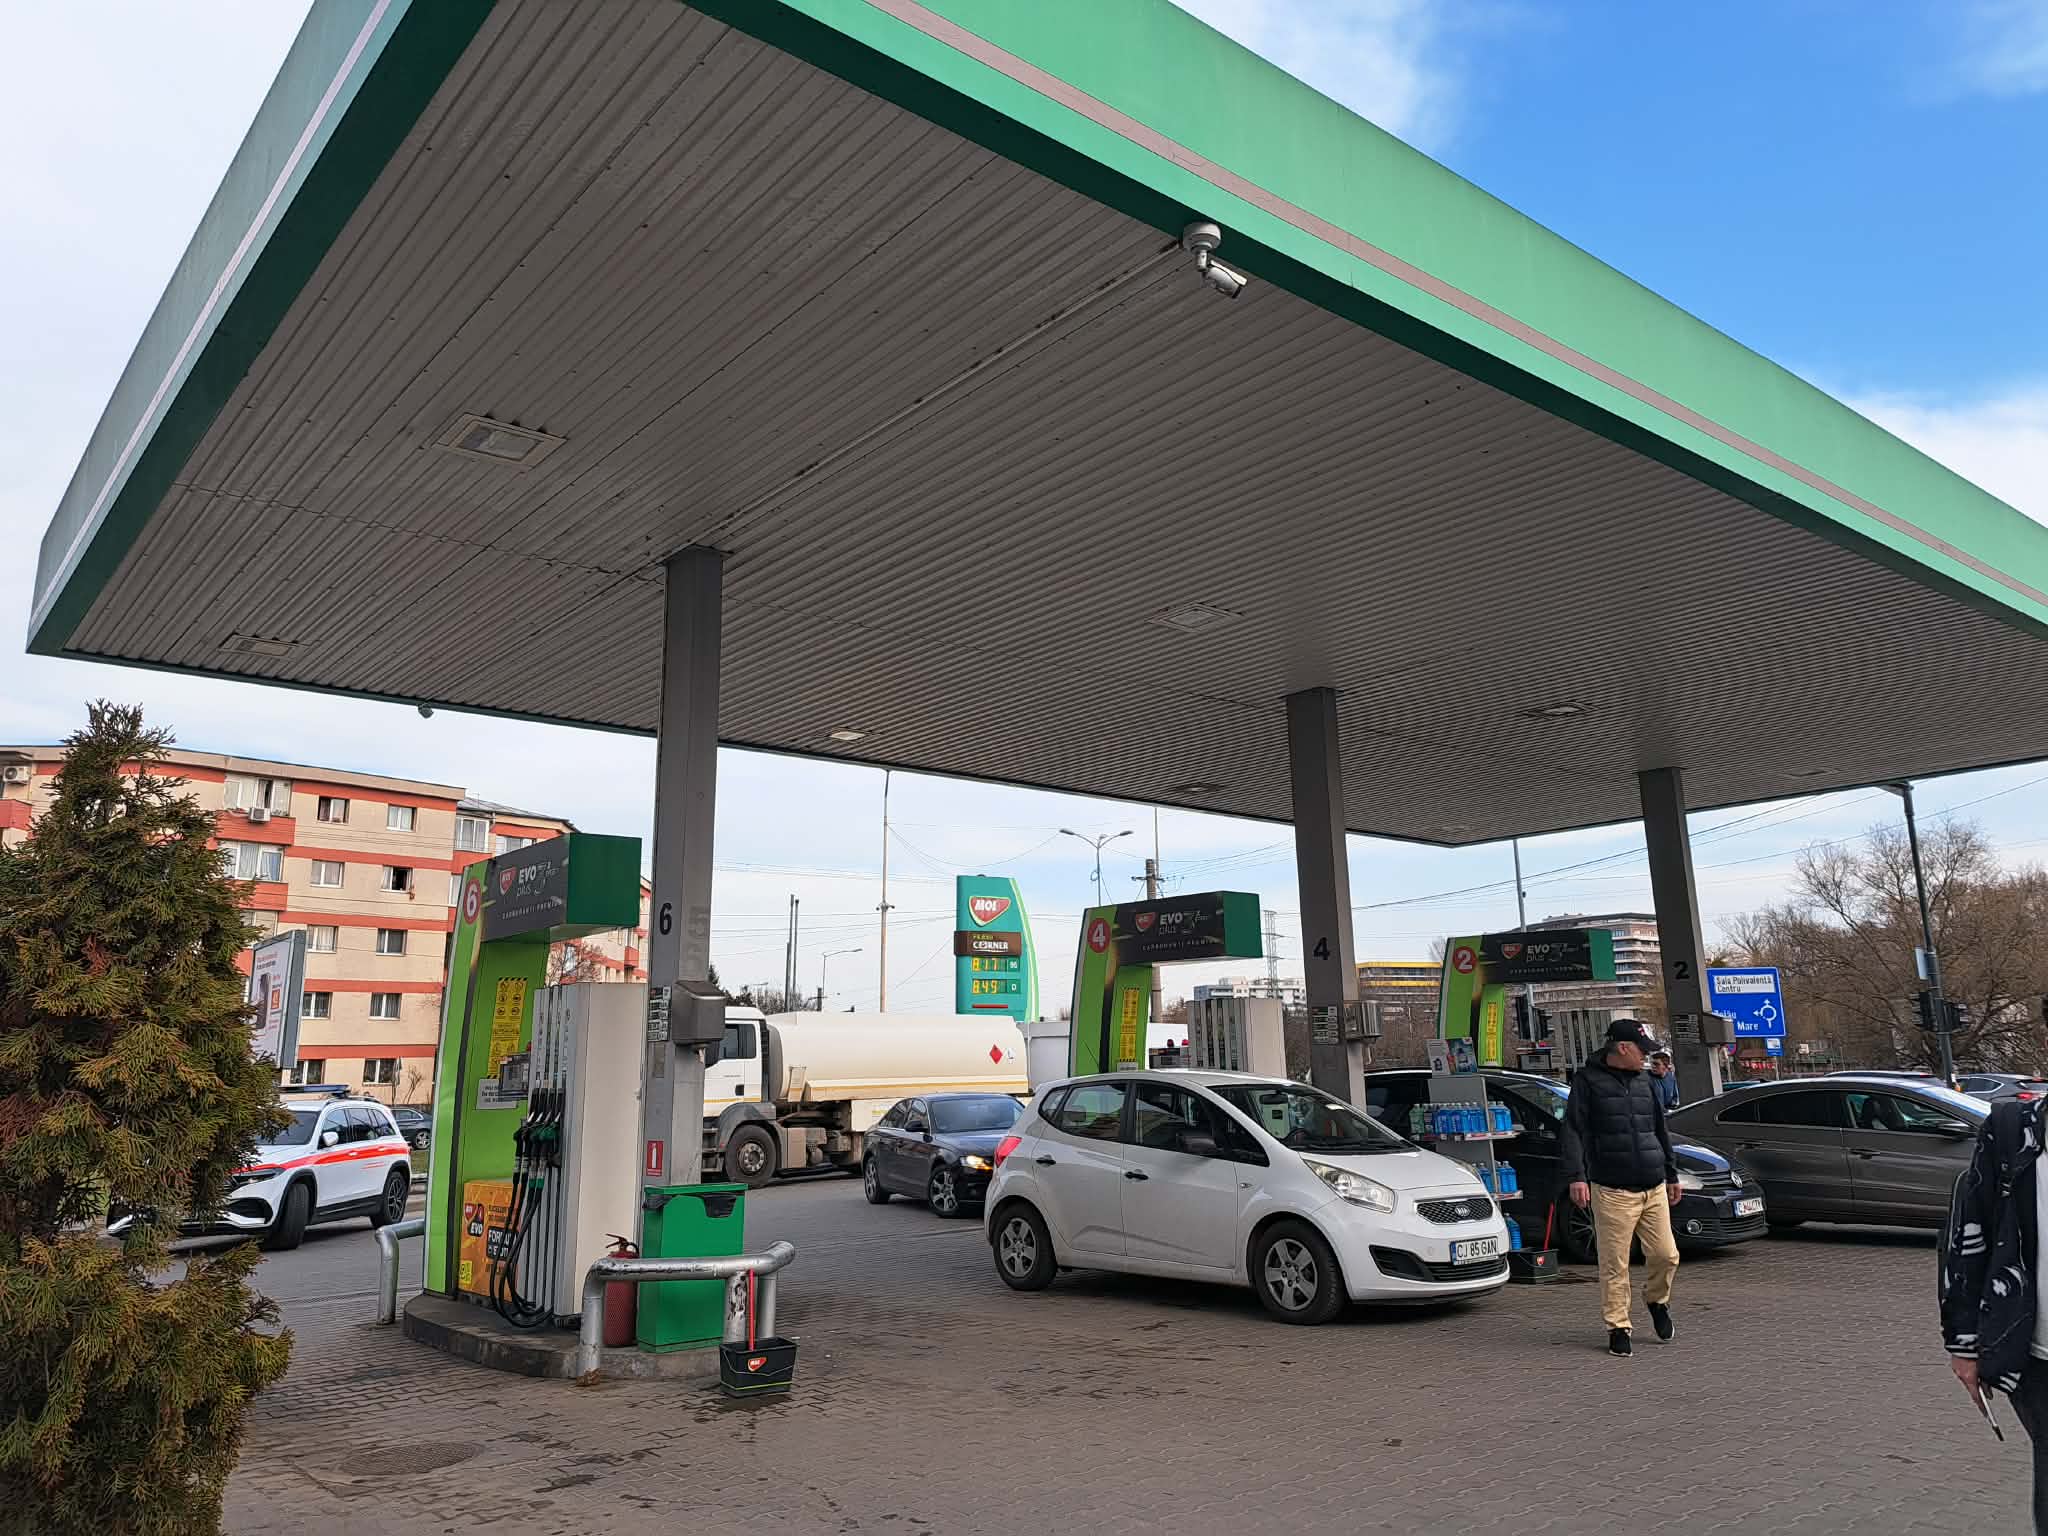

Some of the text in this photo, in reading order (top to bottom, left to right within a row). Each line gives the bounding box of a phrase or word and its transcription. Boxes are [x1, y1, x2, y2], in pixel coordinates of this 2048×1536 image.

[518, 865, 537, 884] EVO
[466, 883, 479, 918] 6
[659, 902, 672, 936] 6
[1159, 912, 1184, 925] EVO
[1092, 923, 1106, 947] 4
[972, 941, 1009, 950] CORNER
[1313, 936, 1331, 961] 4
[1527, 943, 1550, 954] EVO
[1457, 949, 1473, 970] 2
[1673, 961, 1690, 979] 2
[1716, 976, 1732, 985] Sala
[1716, 985, 1742, 993] Centru
[1737, 1021, 1759, 1031] Mare
[470, 1223, 483, 1235] EVO
[1456, 1239, 1497, 1259] CJ 85 GAN
